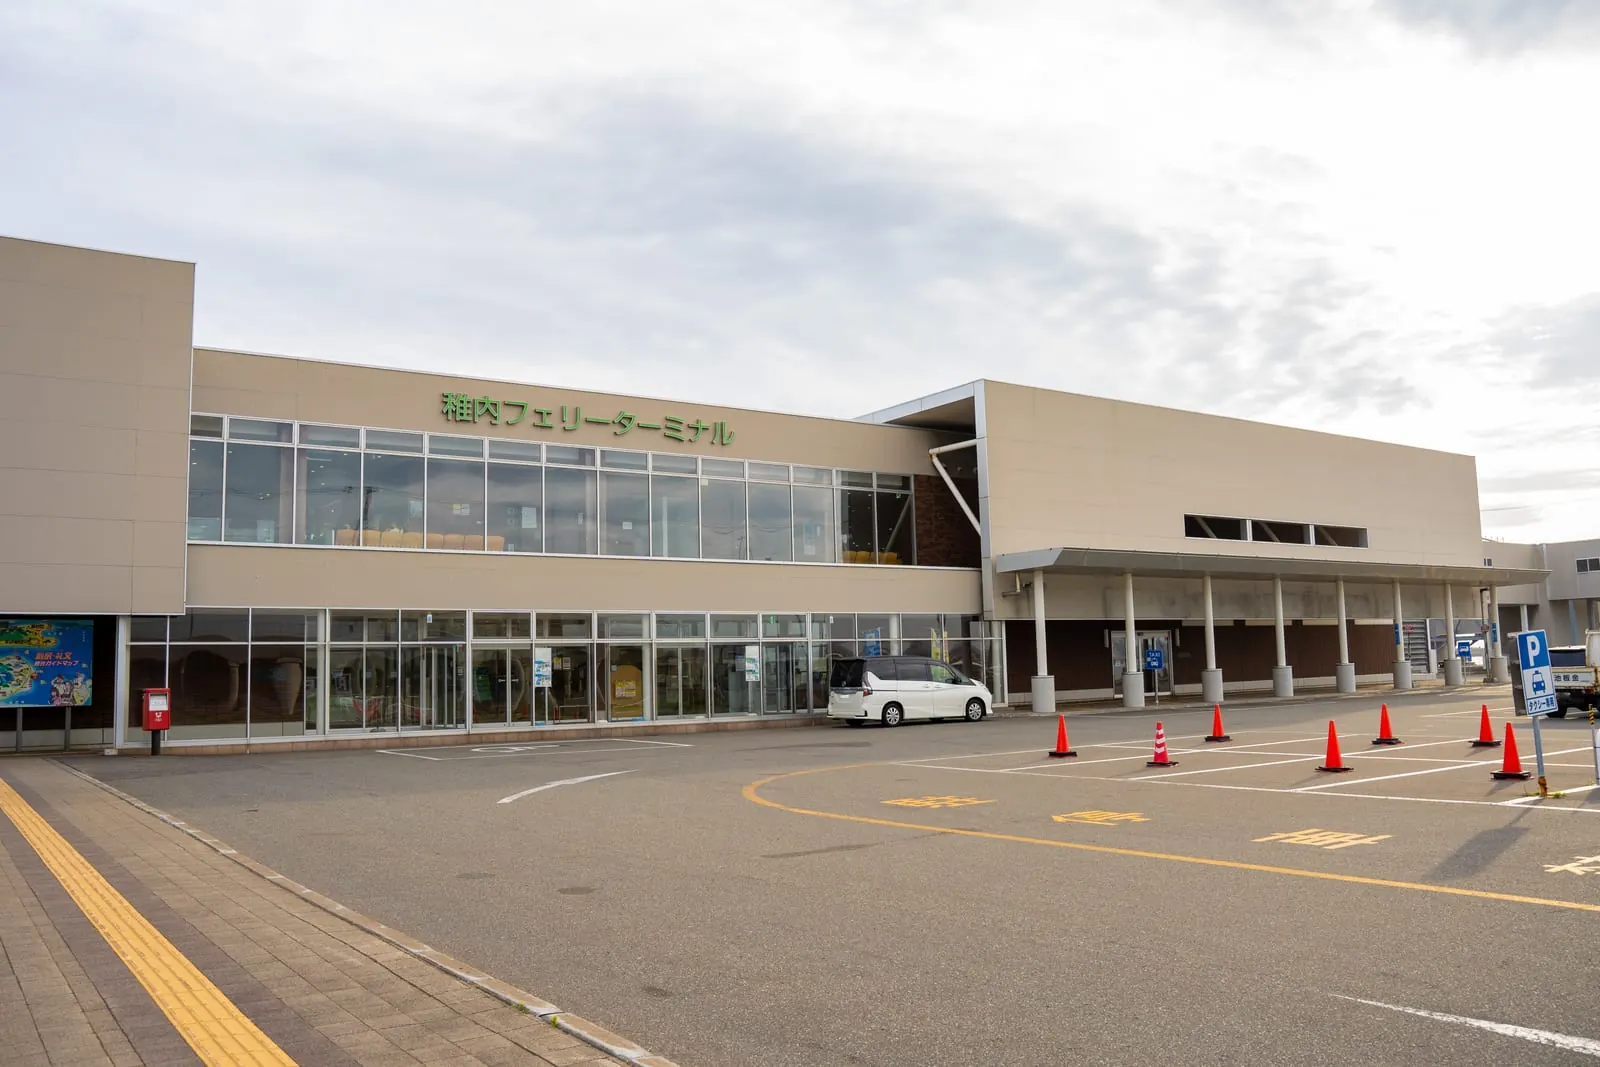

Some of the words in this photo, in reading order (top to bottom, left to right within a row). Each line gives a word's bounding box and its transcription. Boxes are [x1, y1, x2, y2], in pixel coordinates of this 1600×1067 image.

[441, 392, 735, 446] 稚内フェリーターミナル
[1526, 635, 1540, 667] P
